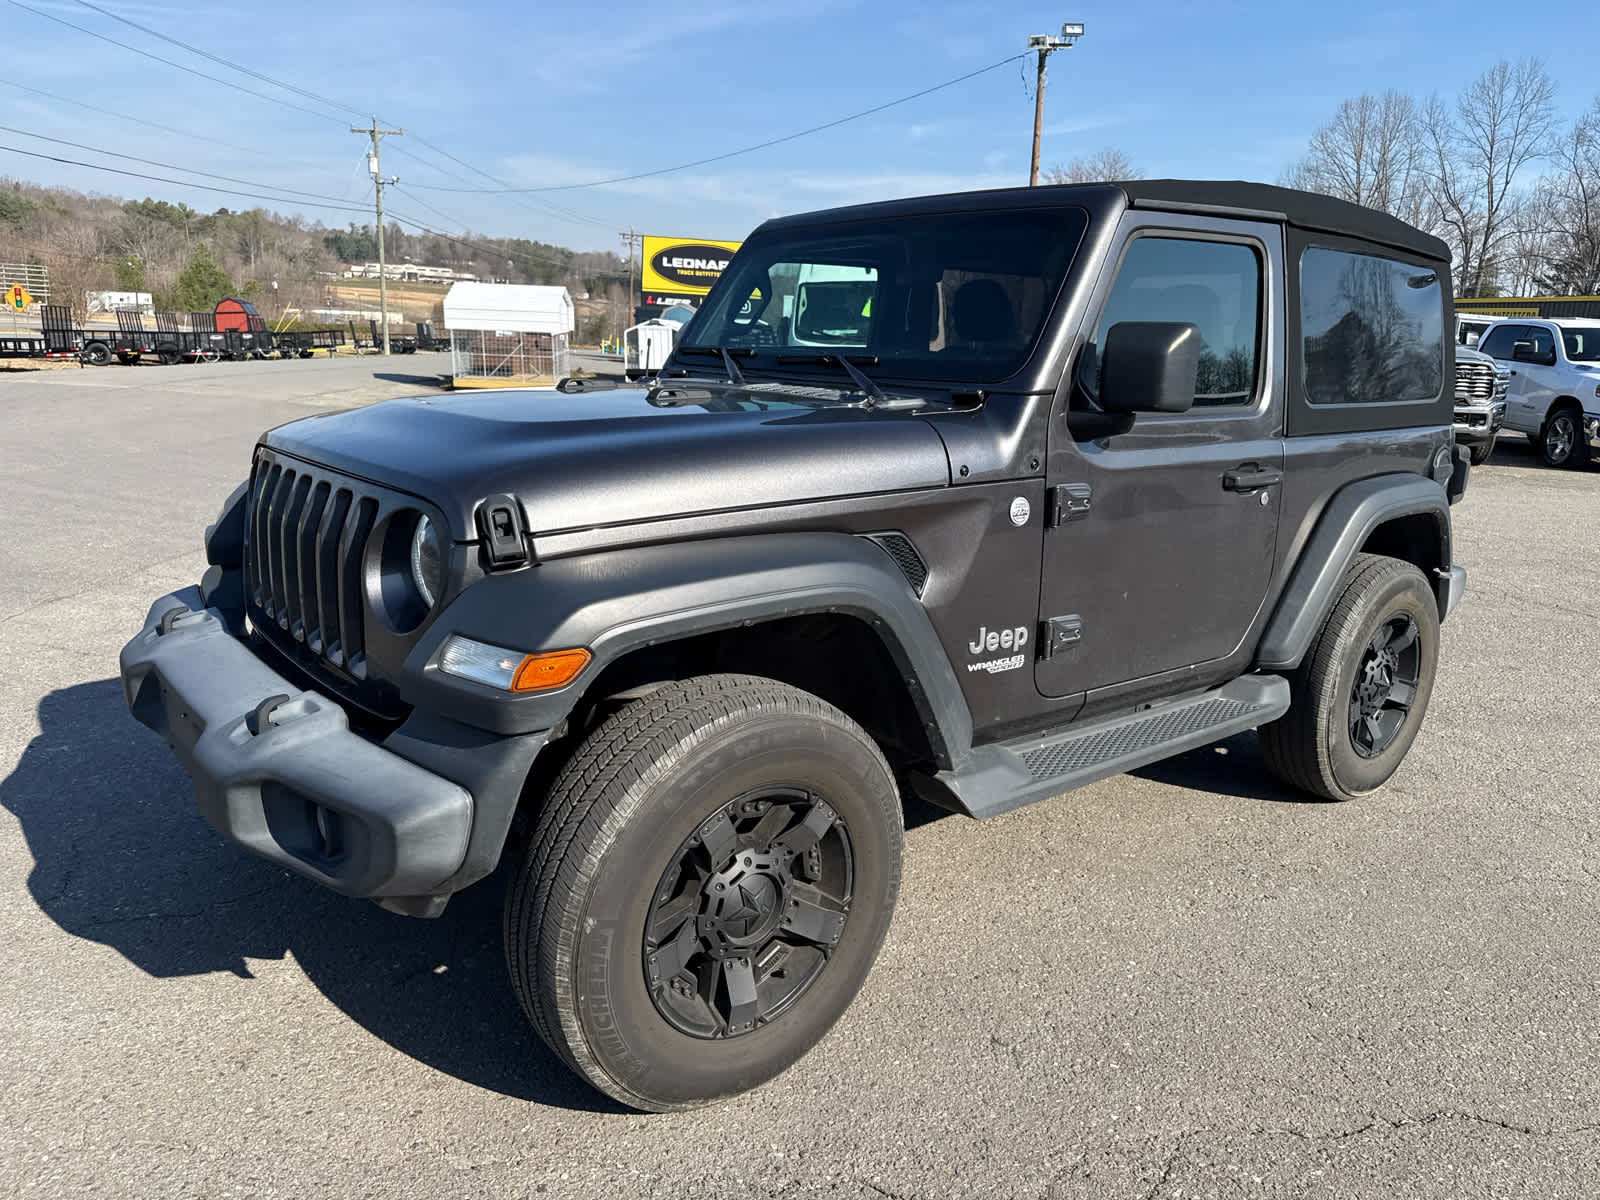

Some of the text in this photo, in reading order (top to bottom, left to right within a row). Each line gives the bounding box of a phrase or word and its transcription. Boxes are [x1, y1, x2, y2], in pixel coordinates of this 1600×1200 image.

[662, 256, 730, 270] LEONAR
[969, 626, 1028, 655] Jeep
[967, 654, 1025, 672] WRANGLER
